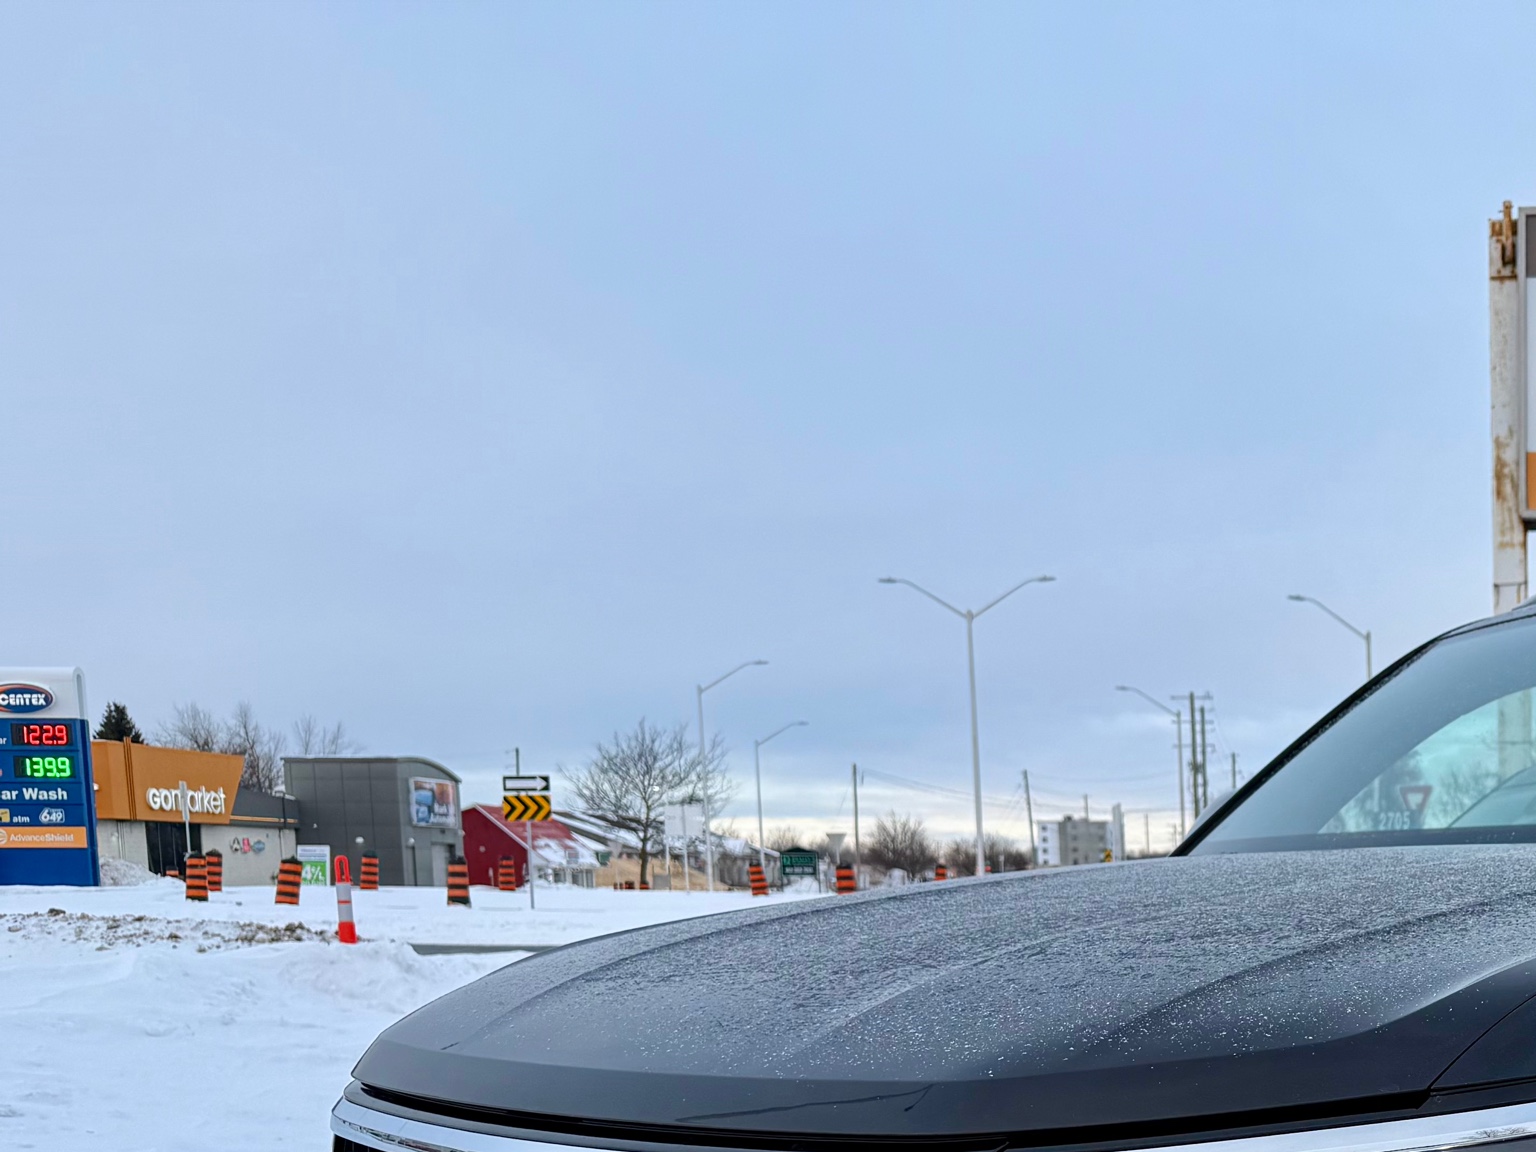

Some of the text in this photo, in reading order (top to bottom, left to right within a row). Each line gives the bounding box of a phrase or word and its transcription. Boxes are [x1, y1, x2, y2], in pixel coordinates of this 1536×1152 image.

[0, 693, 47, 706] CENTEX
[1, 787, 68, 800] ar Wash
[12, 815, 30, 823] atm
[1379, 811, 1411, 830] 2705
[9, 833, 74, 842] AdvanceShield
